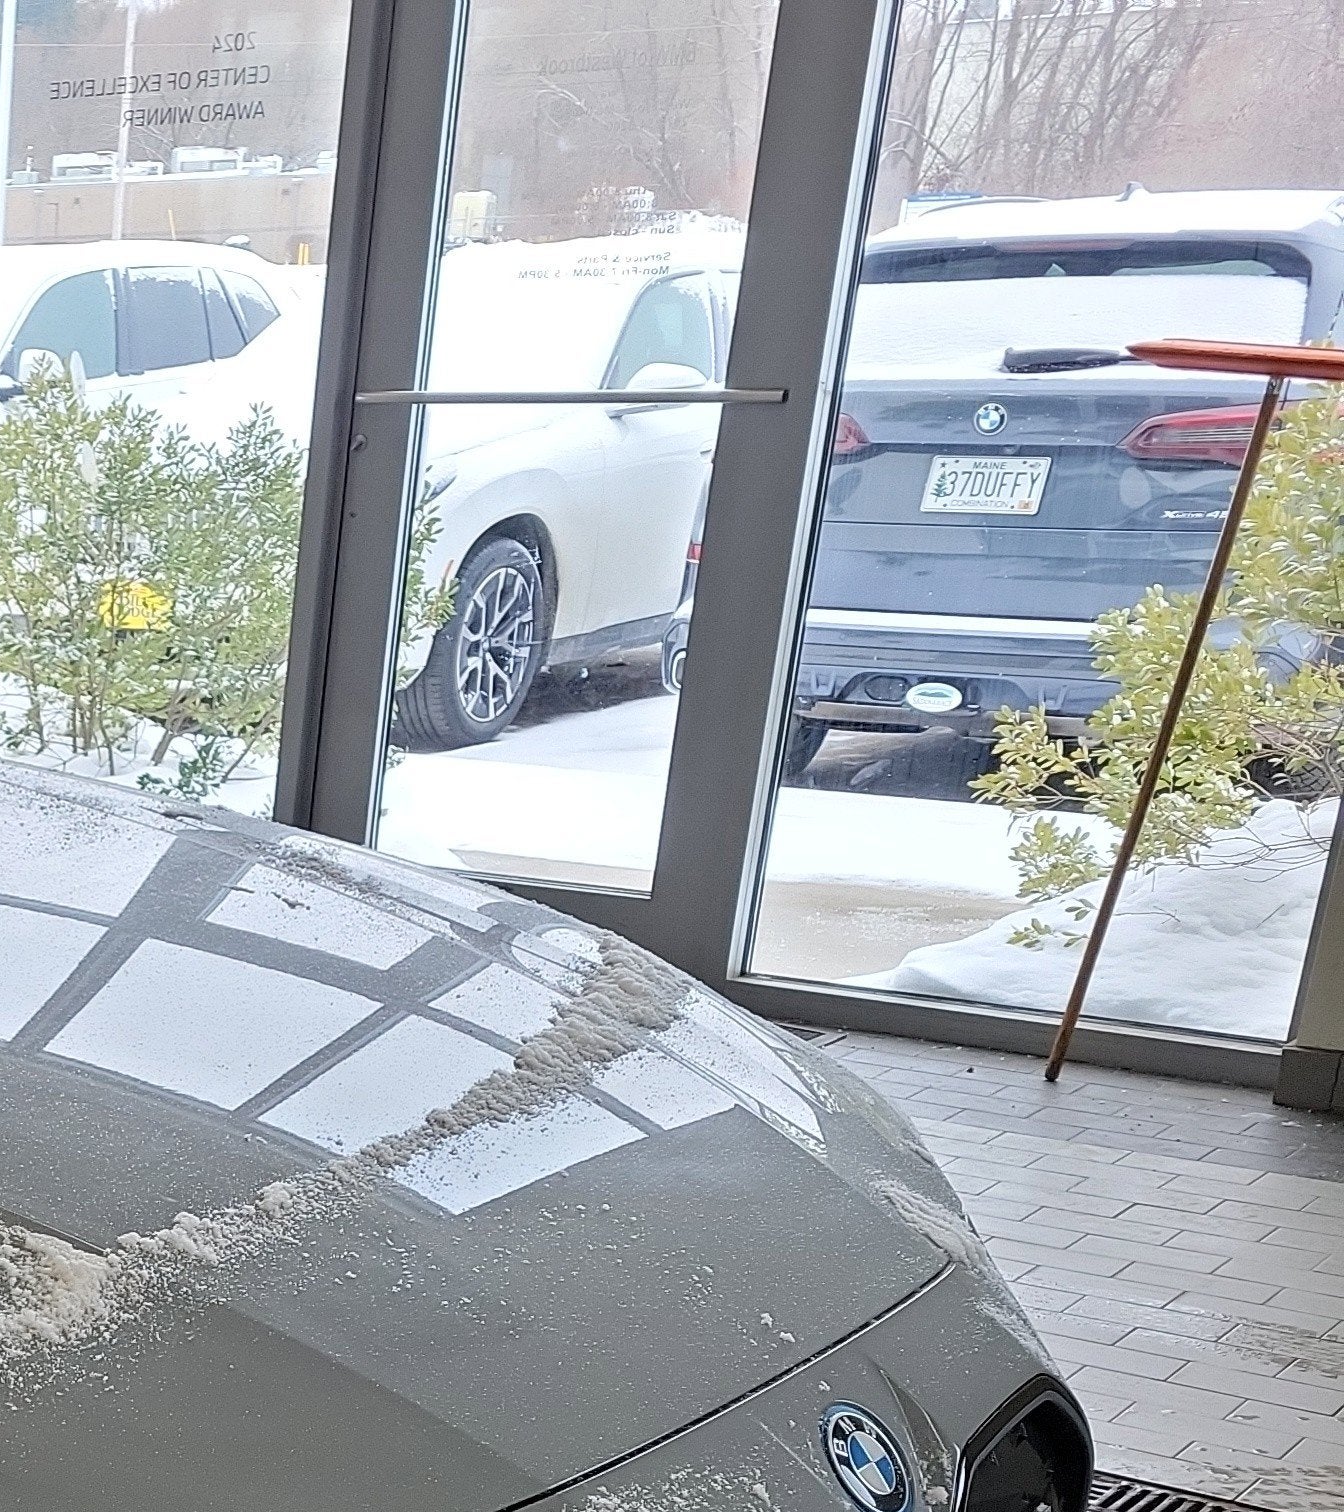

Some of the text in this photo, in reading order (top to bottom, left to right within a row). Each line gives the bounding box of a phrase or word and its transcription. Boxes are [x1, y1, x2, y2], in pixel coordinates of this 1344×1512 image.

[972, 461, 1008, 470] MAINE
[945, 471, 1042, 499] 37DUFFY
[949, 499, 1010, 508] COMBINATION
[832, 1416, 878, 1458] BMW
